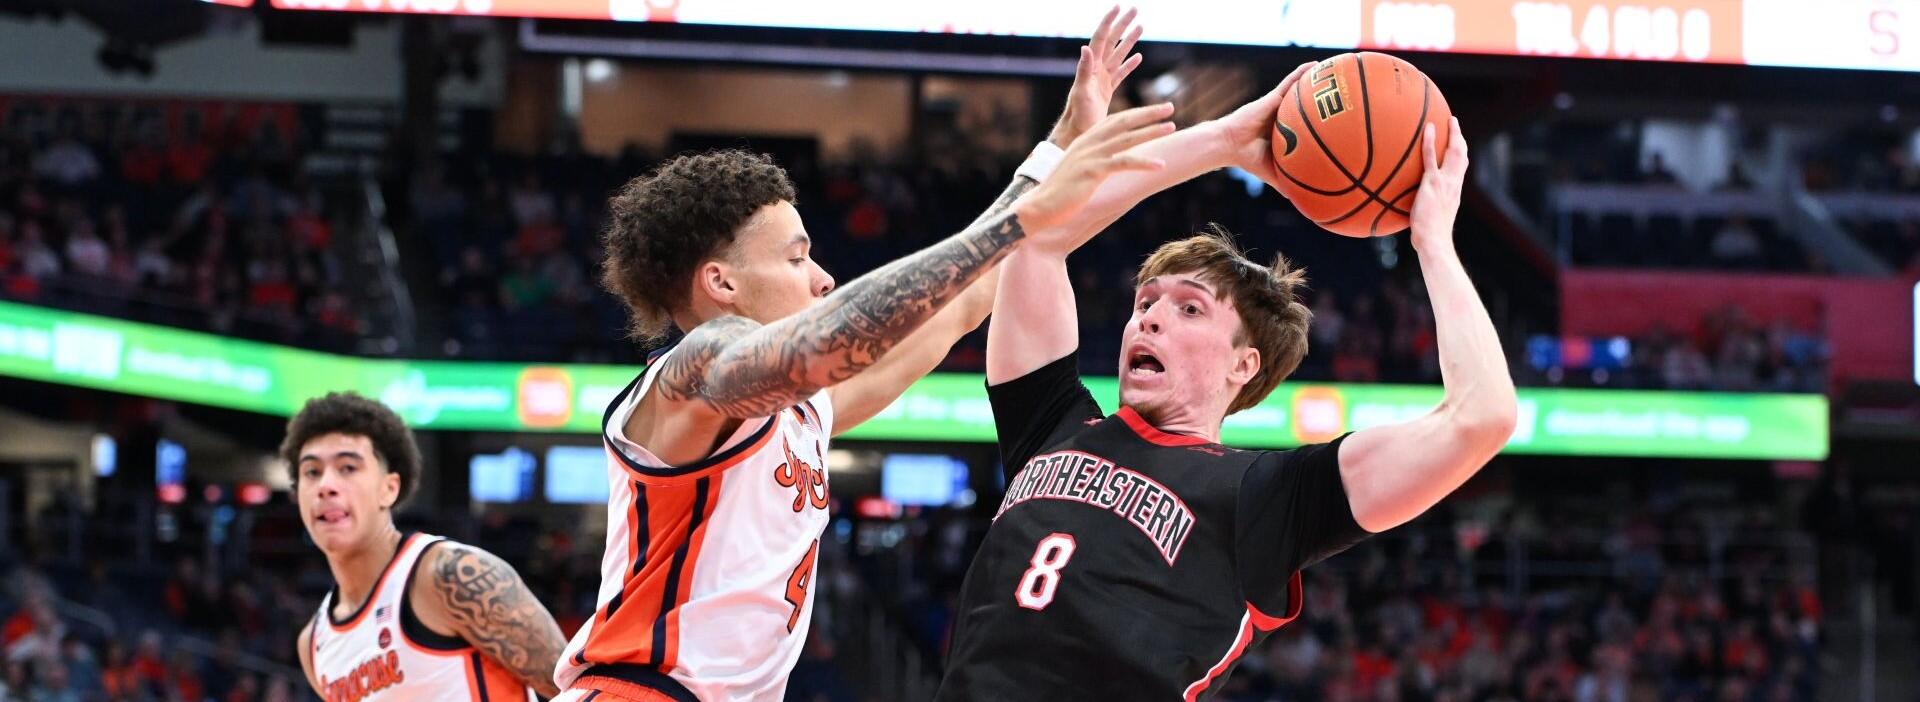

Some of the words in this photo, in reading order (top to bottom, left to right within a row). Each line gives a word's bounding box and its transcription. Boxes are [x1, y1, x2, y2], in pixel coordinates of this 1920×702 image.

[1311, 60, 1346, 122] ELIT
[784, 537, 819, 635] 4
[1015, 532, 1077, 612] 8
